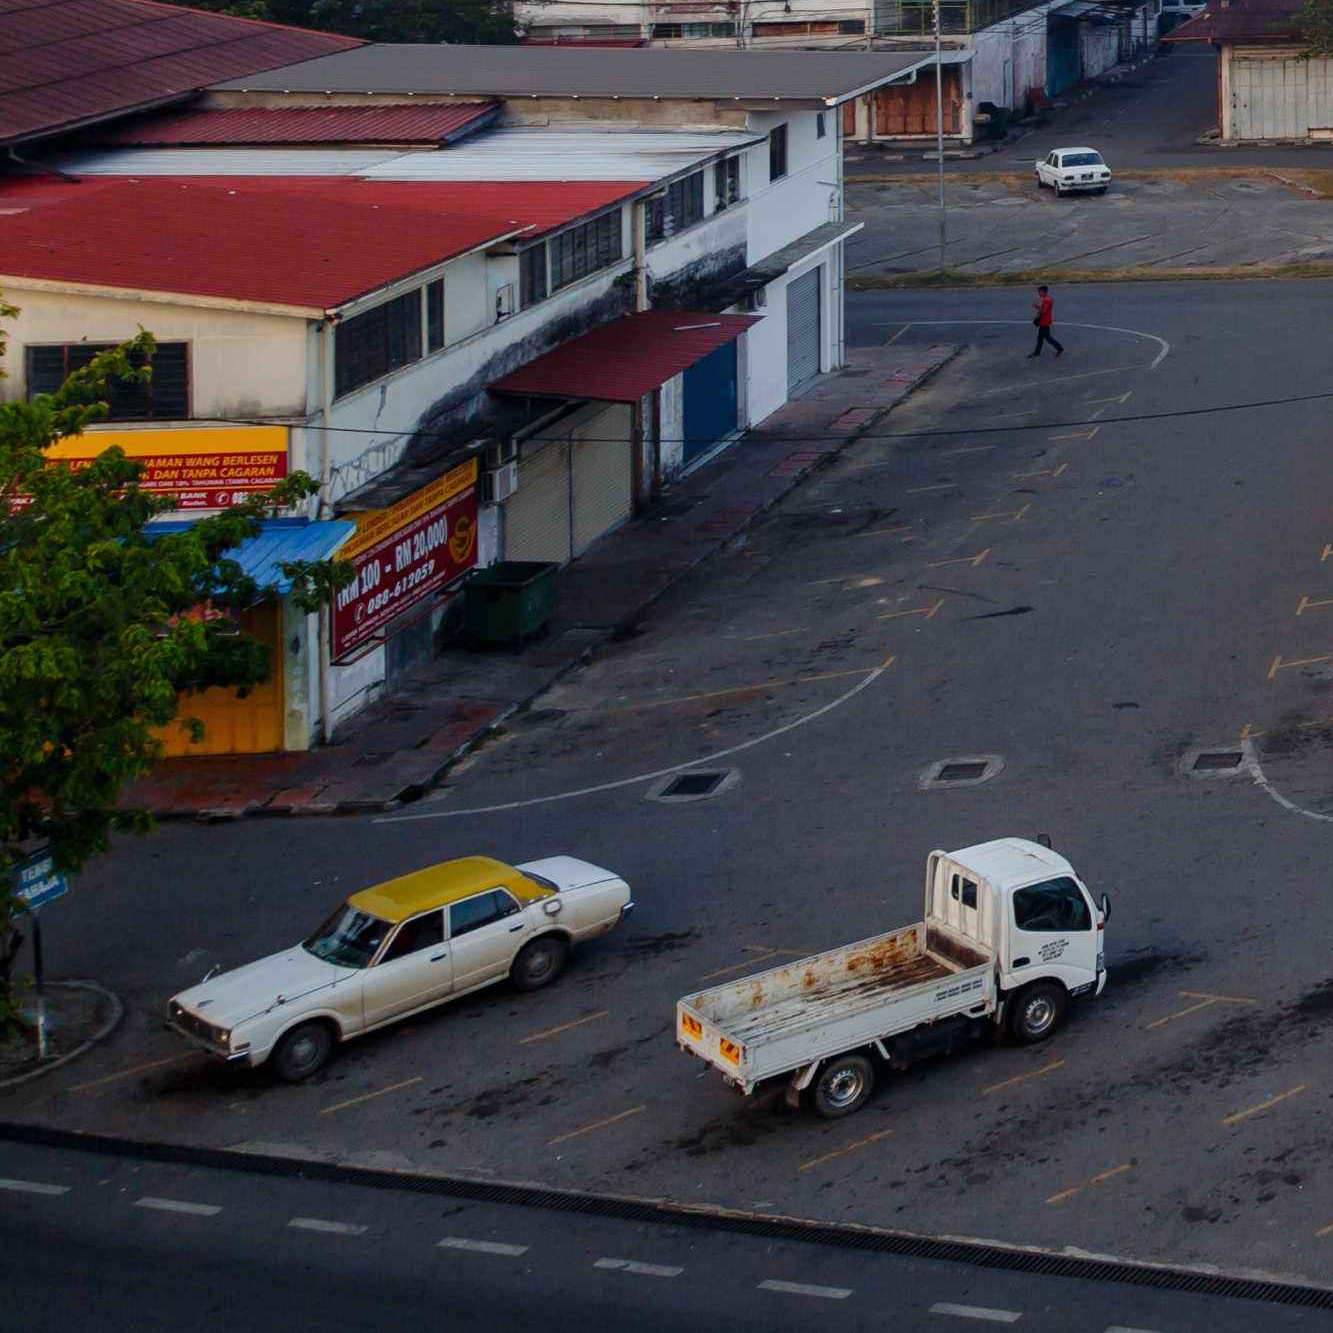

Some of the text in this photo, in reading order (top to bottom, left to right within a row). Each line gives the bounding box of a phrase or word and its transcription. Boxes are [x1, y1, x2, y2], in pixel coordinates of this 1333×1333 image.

[153, 469, 179, 480] DAN
[182, 468, 217, 479] TANPA
[220, 467, 275, 477] CAGARAN
[186, 456, 220, 467] WANG
[223, 455, 278, 466] BERLESEN
[361, 559, 380, 594] 100
[395, 539, 412, 572] RM
[413, 514, 448, 561] 20,000)
[367, 559, 435, 614] 088-612059
